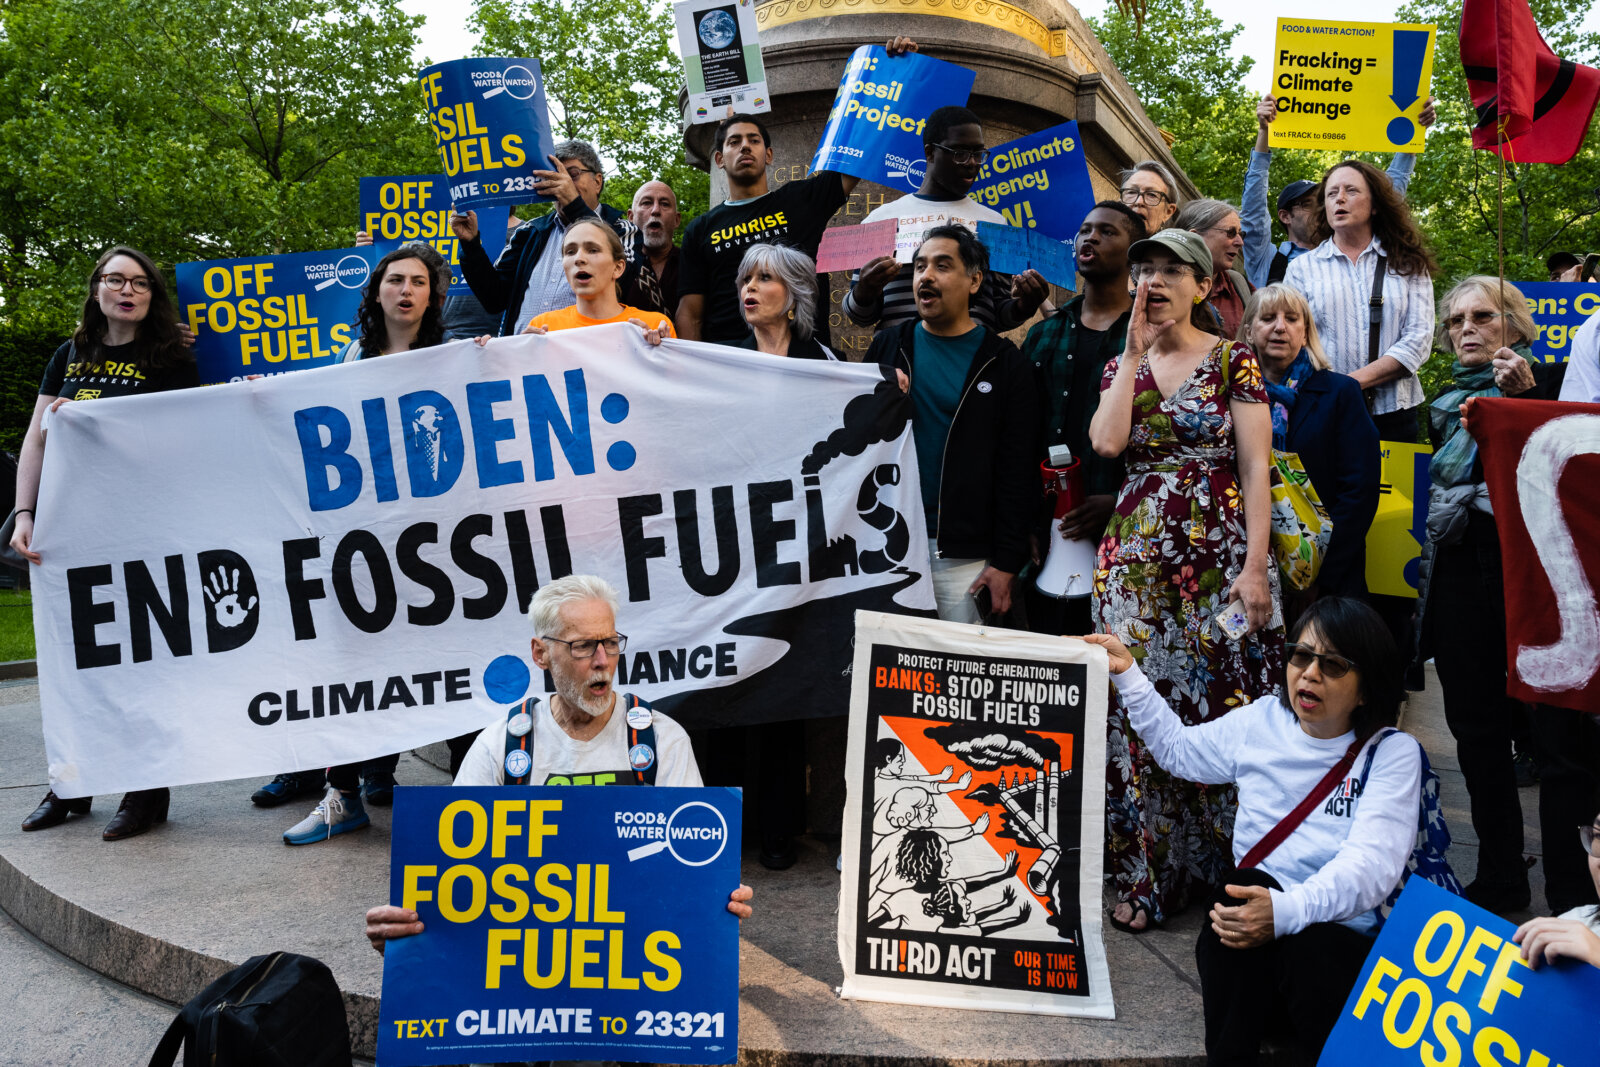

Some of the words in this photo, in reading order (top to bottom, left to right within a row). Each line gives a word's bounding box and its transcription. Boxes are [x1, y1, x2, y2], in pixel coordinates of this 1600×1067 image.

[1282, 25, 1305, 33] FOOD
[1312, 26, 1338, 35] WATER
[1340, 27, 1375, 36] ACTION!
[474, 78, 503, 88] WATER
[506, 78, 534, 86] WATCH
[848, 77, 904, 102] ossil
[1278, 73, 1353, 92] Climate
[1276, 96, 1350, 120] Change
[1288, 131, 1312, 139] FRACK
[1322, 132, 1346, 140] 69866
[837, 145, 864, 158] 23321
[992, 137, 1075, 174] Climate
[884, 160, 908, 172] WATER
[380, 182, 433, 210] OFF
[482, 183, 500, 194] TO
[710, 212, 788, 245] SUNRISE
[714, 226, 788, 253] MOVEMENT
[203, 262, 274, 299] OFF
[306, 271, 334, 280] WATER
[338, 266, 367, 276] WATCH
[187, 294, 318, 336] FOSSIL
[240, 323, 352, 366] FUELS
[294, 368, 636, 512] BIDEN:
[66, 549, 260, 670] END
[617, 463, 910, 603] FUELS
[898, 653, 944, 670] PROTECT
[946, 659, 986, 675] FUTURE
[989, 663, 1060, 681] GENERATIONS
[247, 668, 473, 726] CLIMATE
[876, 666, 941, 694] BANKS:
[948, 674, 994, 700] STOP
[1000, 680, 1080, 706] FUNDING
[912, 692, 977, 722] FOSSIL
[983, 700, 1040, 727] FUELS
[1324, 797, 1354, 818] ACT
[438, 799, 563, 860] OFF
[616, 826, 664, 839] WATER
[670, 827, 722, 840] WATCH
[402, 862, 626, 924] FOSSIL
[485, 928, 682, 992] FUELS
[866, 936, 941, 975] TH!RD
[945, 944, 996, 981] ACT
[1014, 950, 1042, 969] OUR
[1046, 952, 1076, 972] TIME
[1413, 910, 1535, 1015] OFF
[1027, 969, 1042, 986] IS
[1046, 972, 1078, 990] NOW
[394, 1018, 448, 1038] TEXT
[456, 1008, 592, 1036] CLIMATE
[598, 1016, 628, 1035] TO
[634, 1010, 724, 1038] 23321
[1352, 956, 1564, 1067] FOSS
